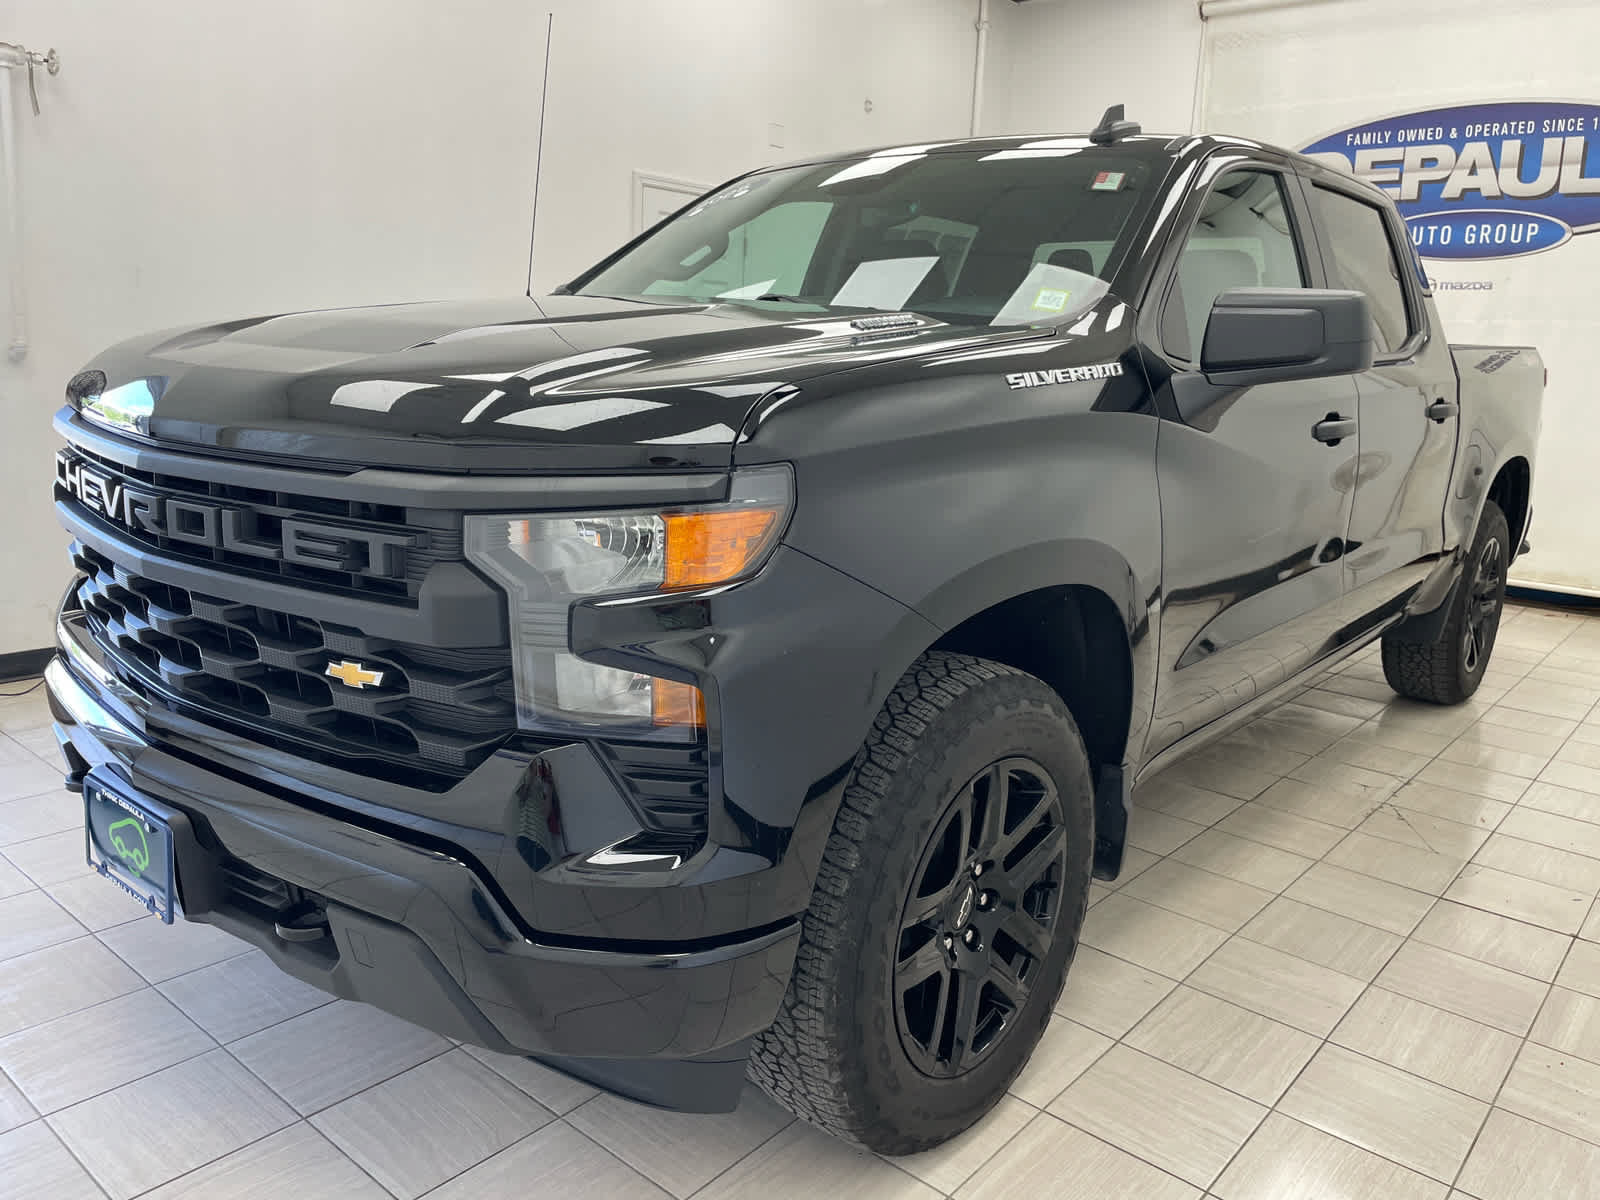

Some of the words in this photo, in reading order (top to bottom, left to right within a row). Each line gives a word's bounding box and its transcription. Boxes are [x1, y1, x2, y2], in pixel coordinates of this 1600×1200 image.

[1346, 130, 1391, 146] FAMILY
[1398, 127, 1443, 143] OWNED
[1449, 127, 1458, 139] &
[1465, 120, 1535, 138] OPERATED
[1542, 117, 1584, 133] SINCE
[1300, 136, 1600, 201] EPAUL
[1412, 224, 1452, 246] UTO
[1464, 223, 1539, 245] GROUP
[1005, 362, 1124, 390] SILVERADO
[55, 448, 422, 577] CHEVROLET
